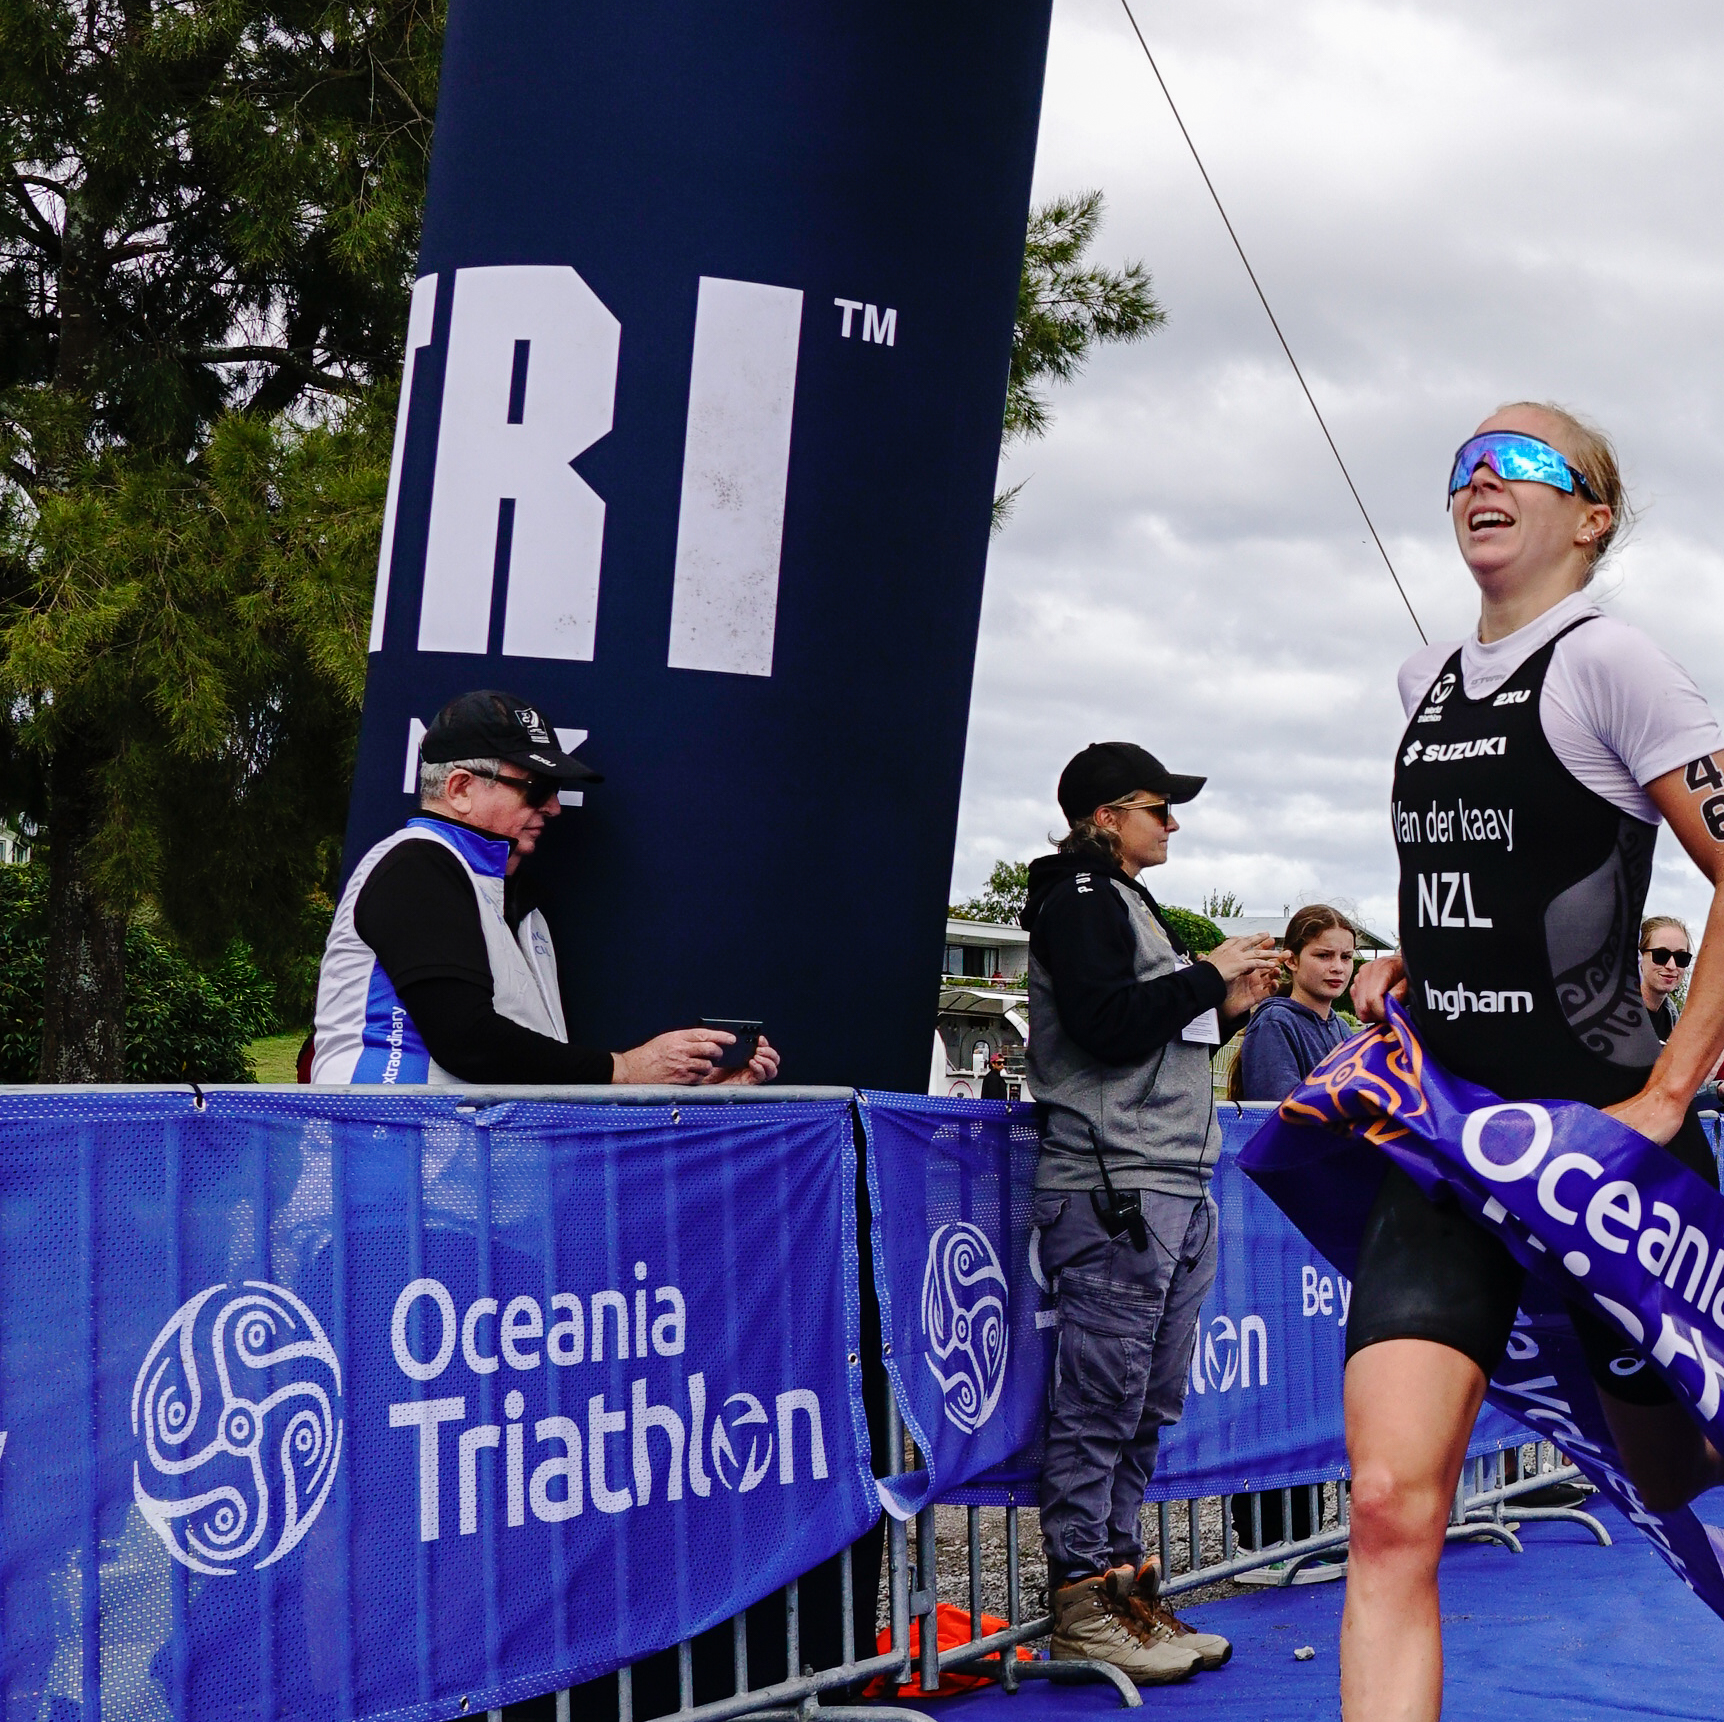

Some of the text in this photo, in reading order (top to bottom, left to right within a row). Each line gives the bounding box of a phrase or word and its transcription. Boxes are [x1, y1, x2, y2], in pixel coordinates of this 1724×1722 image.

[368, 264, 804, 677] RI
[1493, 689, 1531, 706] 2XU
[1422, 736, 1507, 762] SUZUKI
[1392, 798, 1514, 852] Van der kaay
[1418, 871, 1493, 928] NZL
[1424, 979, 1534, 1021] Ingham
[1301, 1265, 1334, 1318] Be
[390, 1260, 687, 1382] Oceania
[388, 1370, 831, 1544] Triathlon
